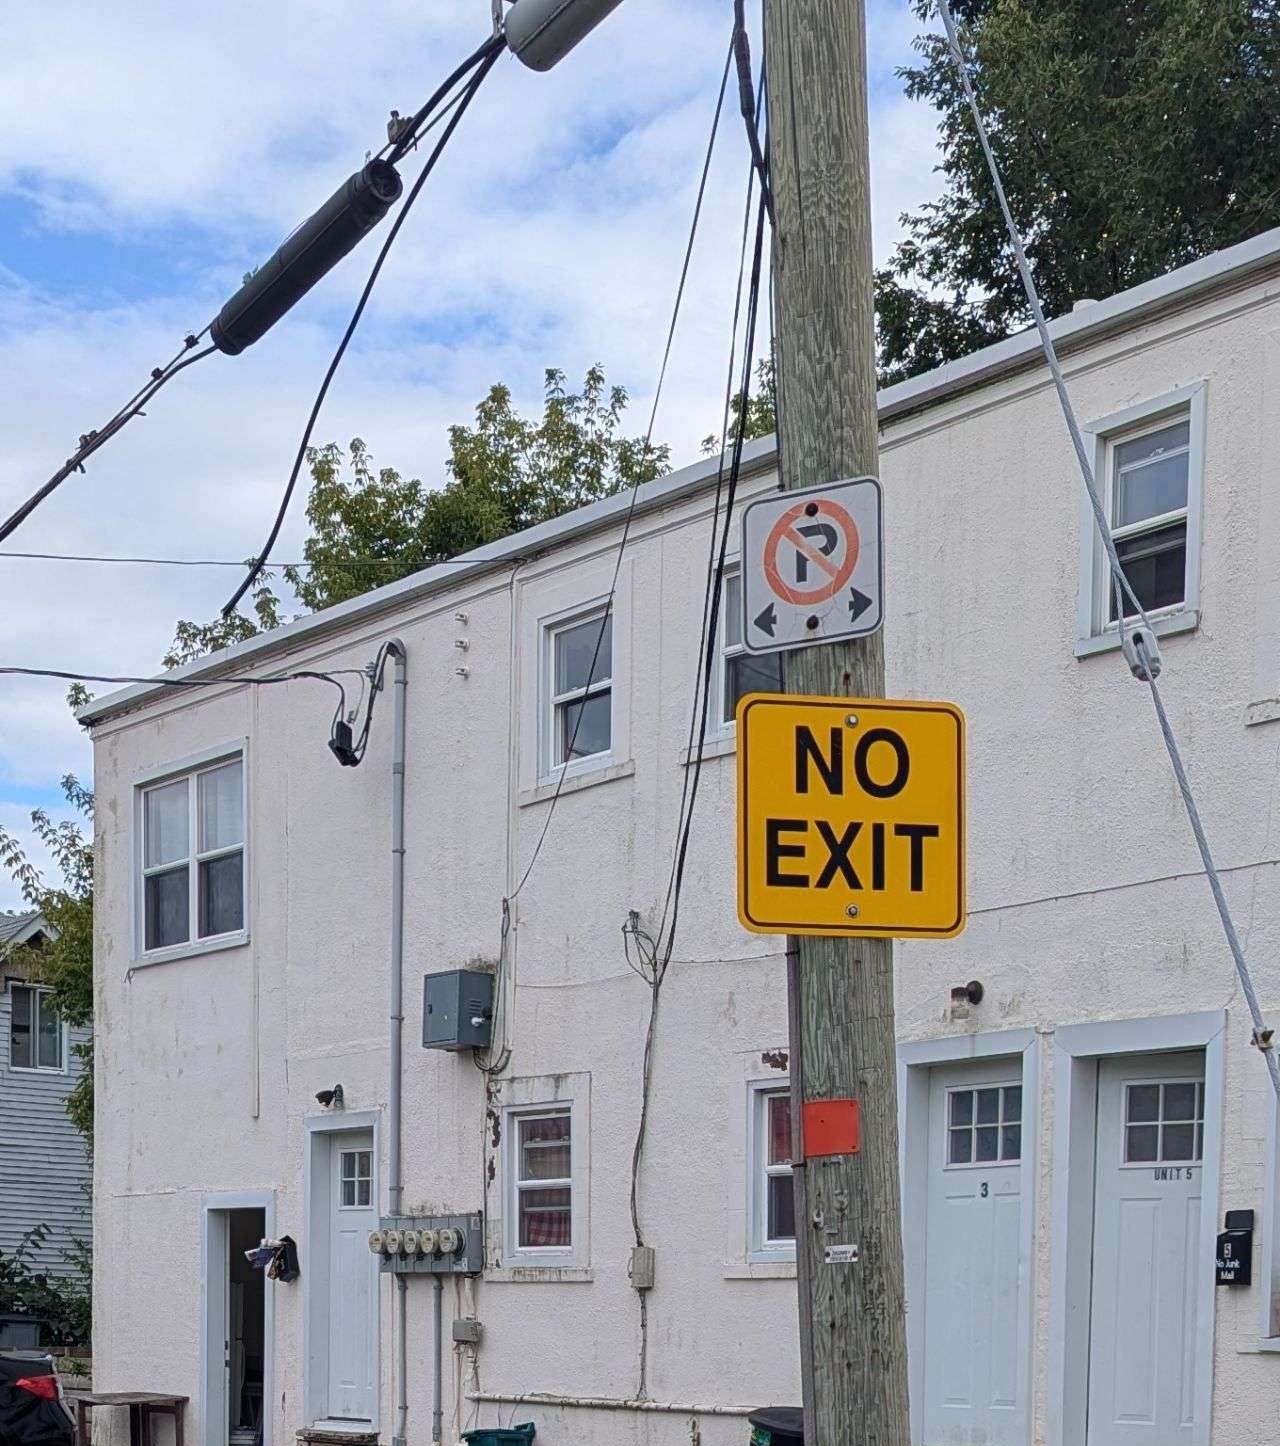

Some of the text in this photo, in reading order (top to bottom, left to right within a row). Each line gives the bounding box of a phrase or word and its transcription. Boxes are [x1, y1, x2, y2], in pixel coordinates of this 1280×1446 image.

[795, 724, 910, 799] NO
[765, 817, 940, 893] EXIT
[1154, 1167, 1193, 1181] UNIT 5
[980, 1182, 989, 1198] 3
[1224, 1244, 1231, 1256] 5
[1225, 1259, 1240, 1268] Junk
